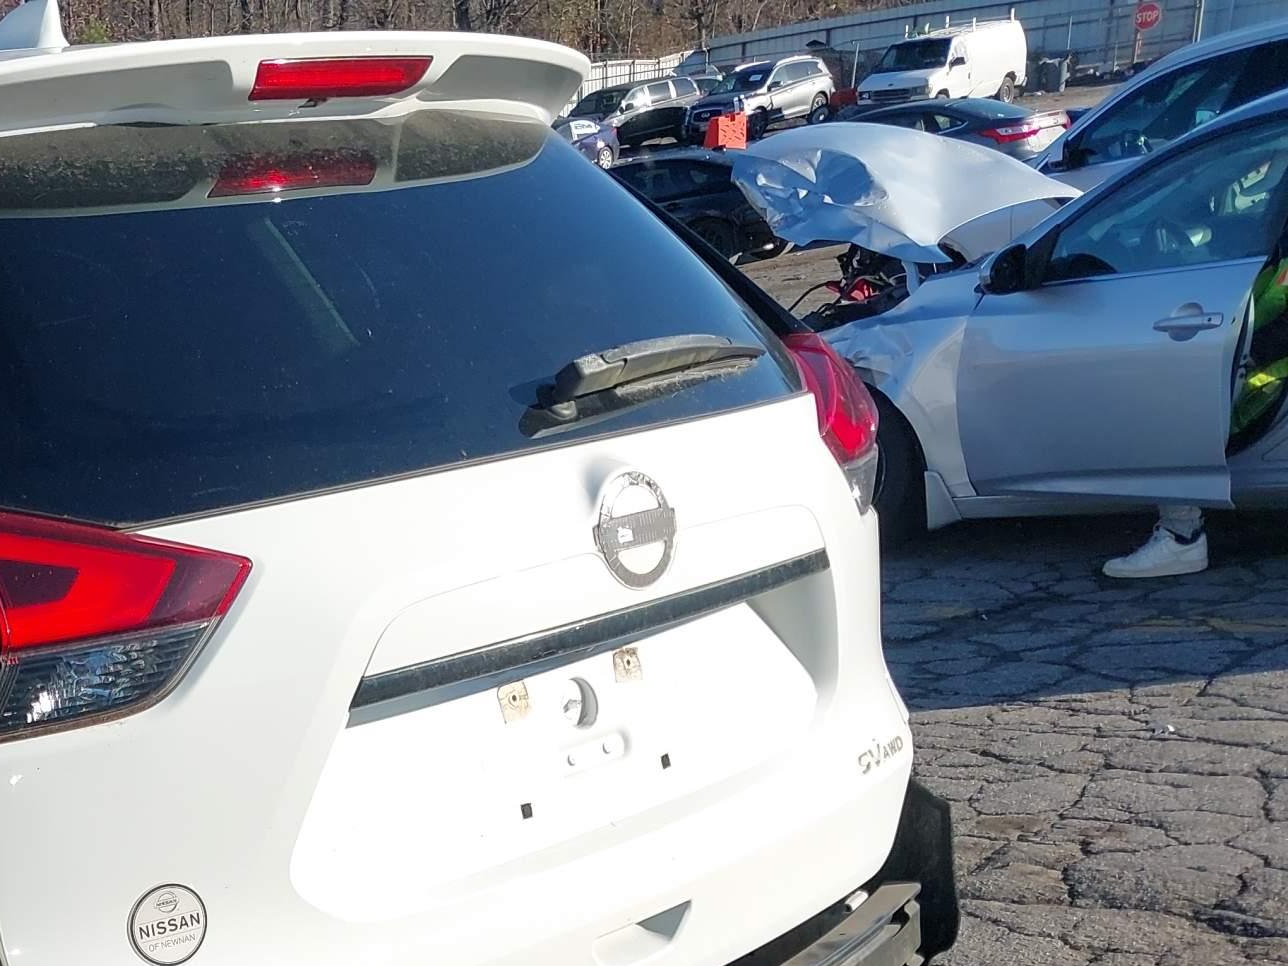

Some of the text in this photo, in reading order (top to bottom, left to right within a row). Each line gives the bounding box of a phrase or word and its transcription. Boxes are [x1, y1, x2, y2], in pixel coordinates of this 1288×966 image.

[1136, 10, 1159, 24] STOP
[138, 912, 201, 940] NISSAN
[148, 942, 160, 952] OF
